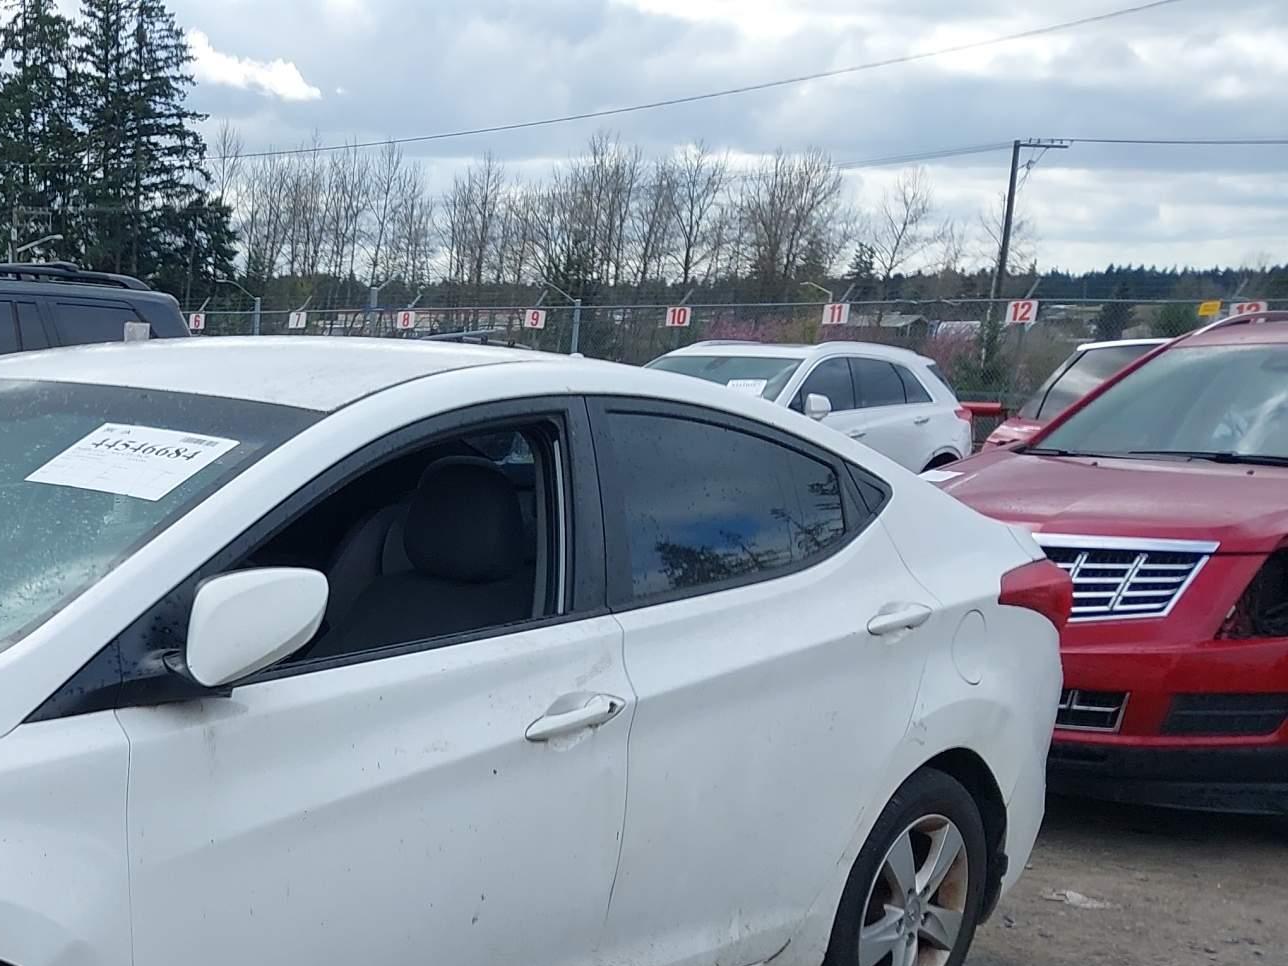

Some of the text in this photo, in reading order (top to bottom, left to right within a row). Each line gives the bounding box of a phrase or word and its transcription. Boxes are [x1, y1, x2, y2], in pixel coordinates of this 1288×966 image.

[402, 312, 410, 327] 8
[530, 311, 540, 327] 9
[670, 308, 687, 325] 10
[829, 304, 845, 323] 11
[1012, 301, 1033, 321] 12
[193, 314, 201, 328] 6
[91, 437, 202, 461] 44546684
